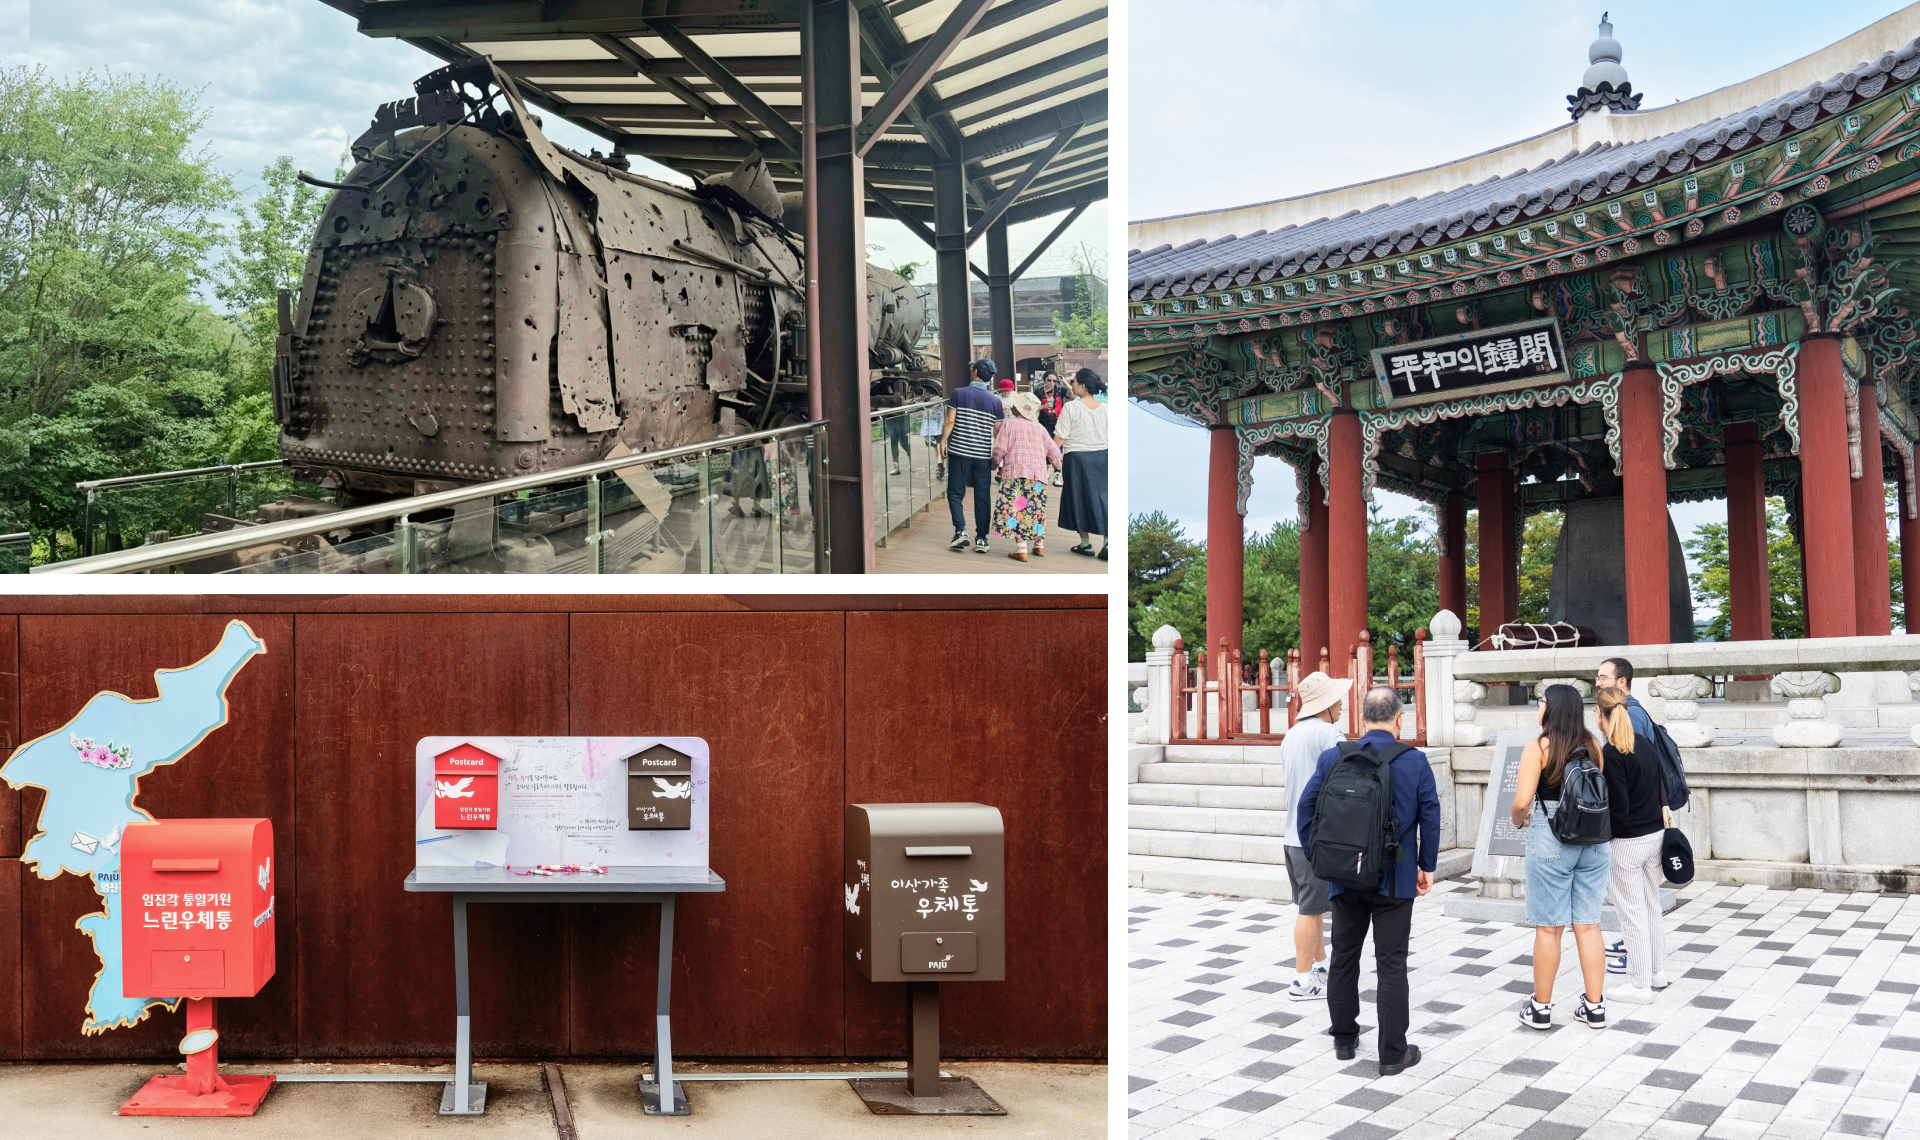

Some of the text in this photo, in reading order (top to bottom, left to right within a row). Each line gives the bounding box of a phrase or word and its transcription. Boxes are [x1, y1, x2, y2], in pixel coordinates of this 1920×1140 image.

[449, 758, 484, 766] Postcard
[642, 758, 677, 766] Postcard
[460, 813, 491, 821] 느린우체통
[97, 873, 119, 881] PAJU
[891, 877, 949, 893] 이산가족
[142, 893, 232, 907] 임진각 통일기원
[916, 894, 979, 921] 우체통
[143, 911, 233, 930] 느린우체통
[928, 961, 948, 969] PAJU
